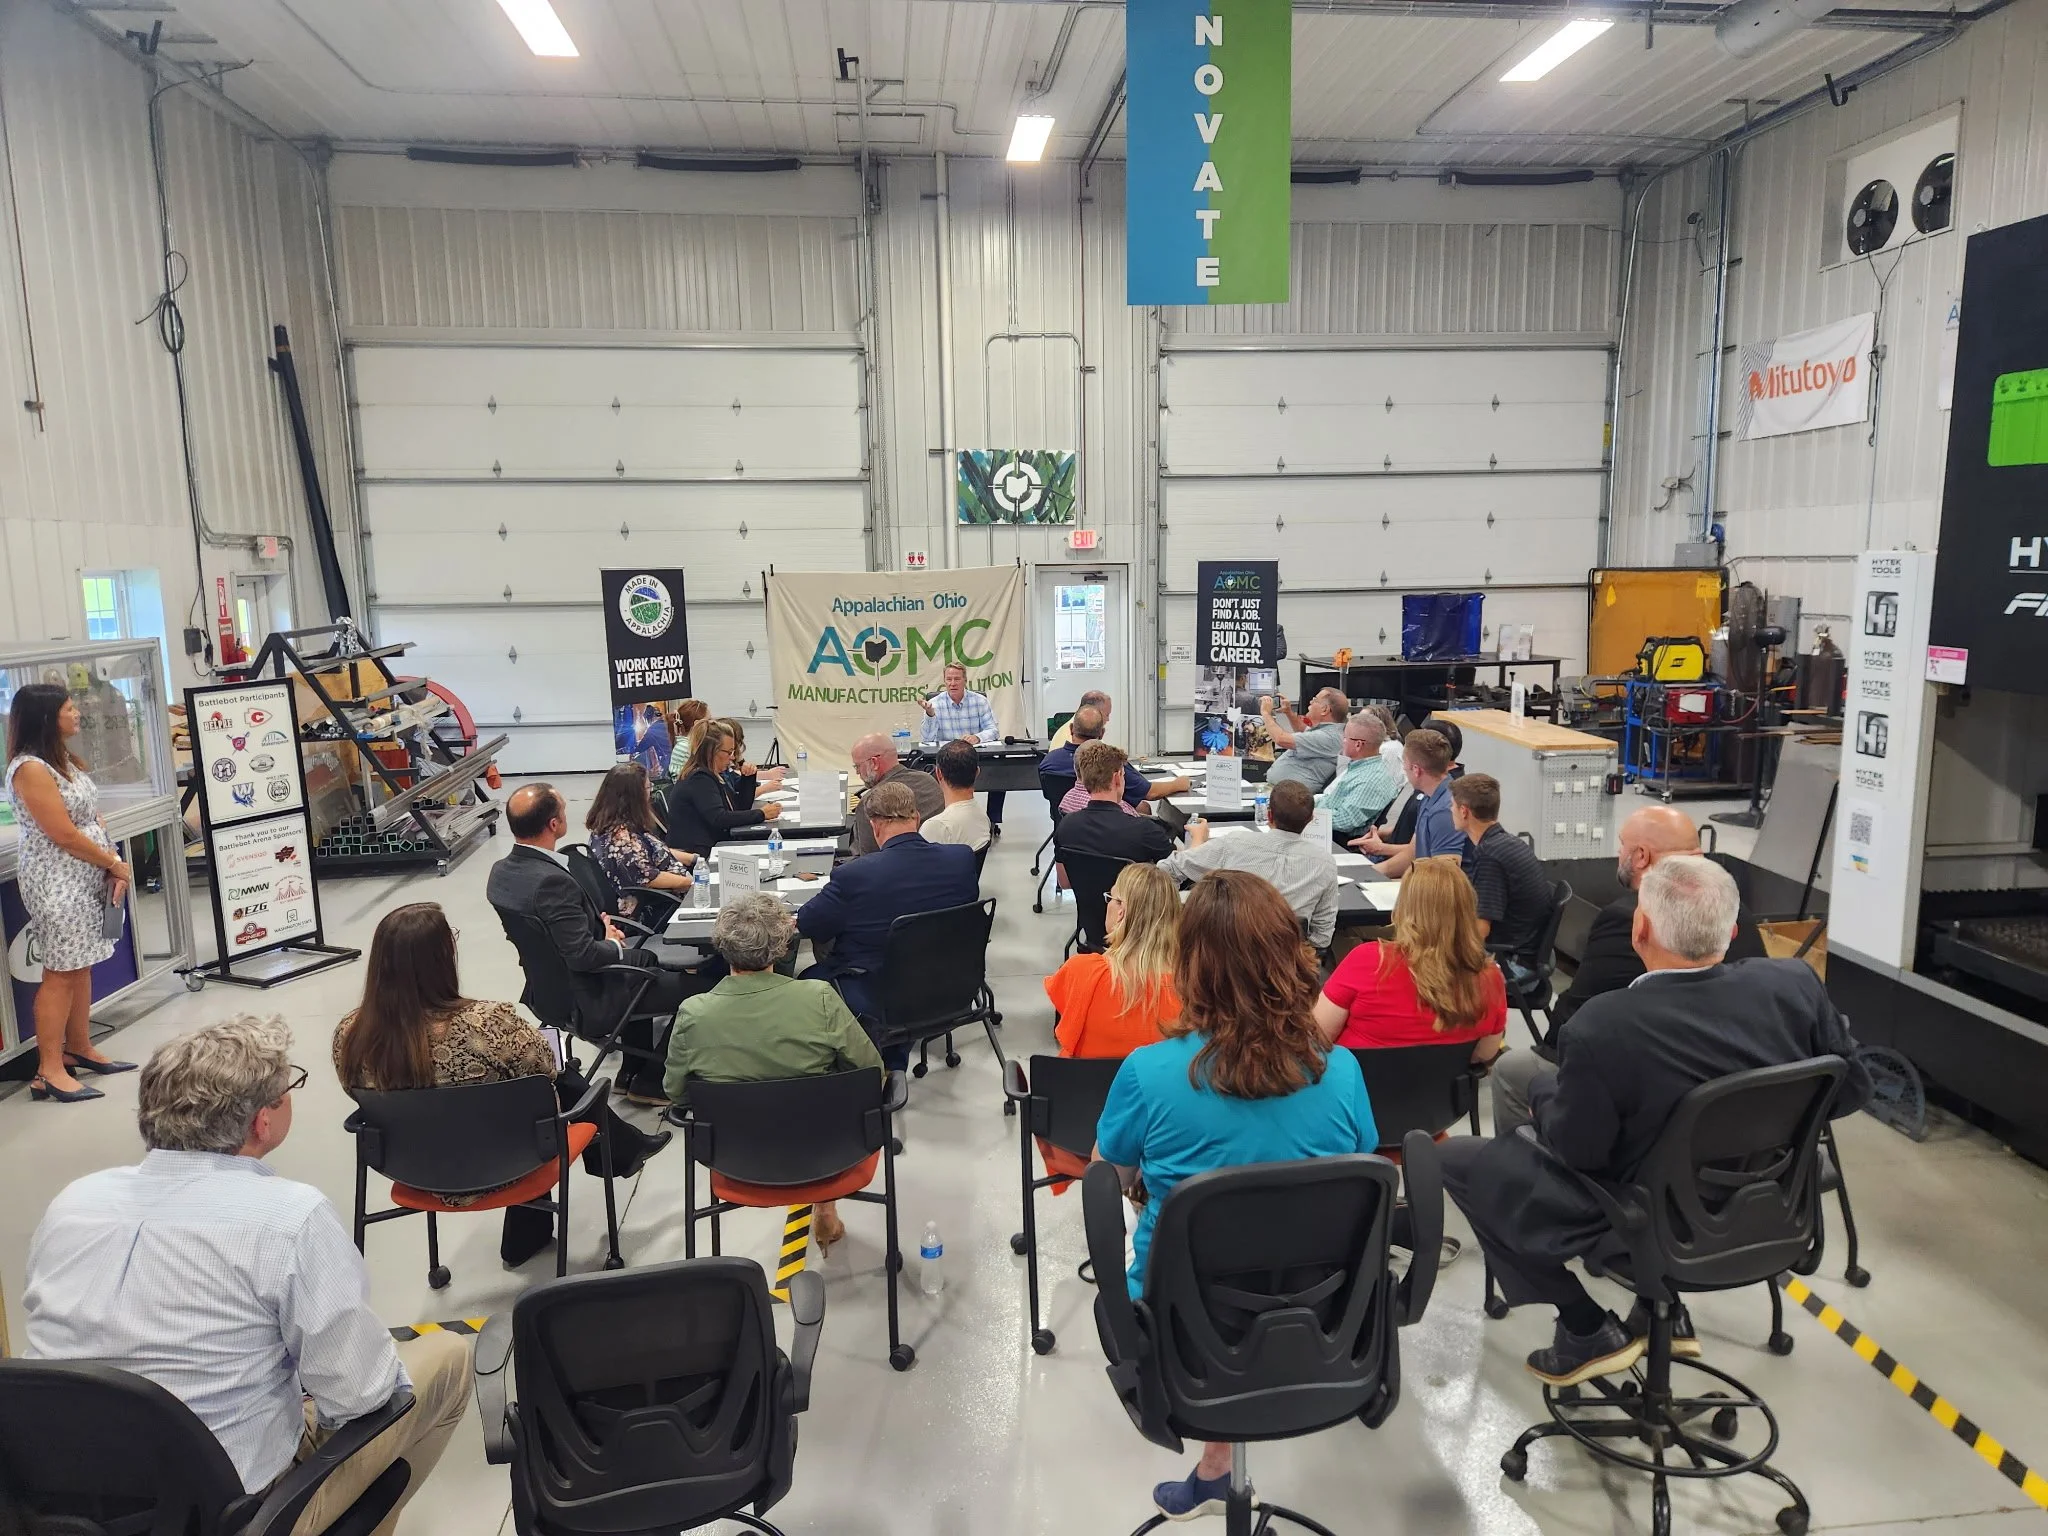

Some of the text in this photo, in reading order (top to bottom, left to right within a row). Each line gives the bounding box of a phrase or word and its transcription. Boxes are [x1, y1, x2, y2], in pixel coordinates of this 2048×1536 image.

[1193, 15, 1224, 287] NOVATE
[1749, 356, 1857, 399] Mitutoyo
[1073, 531, 1095, 546] EXIT
[625, 577, 658, 594] MADE IN
[1214, 575, 1260, 590] AOMC
[832, 592, 968, 617] Appalachian Ohio
[1212, 598, 1261, 609] DON'T JUST
[626, 606, 670, 635] APPALACHIA
[1212, 609, 1261, 620] FIND A JOB.
[1211, 621, 1262, 631] LEARN A SKILL.
[1211, 630, 1261, 647] BUILD A
[806, 618, 994, 676] AOMC
[1210, 647, 1264, 664] CAREER.
[1864, 651, 1893, 659] HYTEK
[615, 654, 684, 673] WORK READY
[1864, 659, 1893, 667] TOOLS
[617, 668, 685, 689] LIFE READY
[1862, 680, 1890, 688] HYTEK
[198, 691, 285, 707] Battlebot Participants
[788, 683, 929, 704] MANUFACTURERS'
[1862, 688, 1890, 697] TOOLS
[1855, 769, 1883, 778] HYTEK
[1855, 776, 1884, 788] TOOLS
[218, 828, 304, 851] Battlebot Arena Sponsors!
[235, 832, 255, 841] Thank
[256, 830, 269, 838] you
[725, 879, 754, 890] Welcome
[244, 902, 268, 915] EZG
